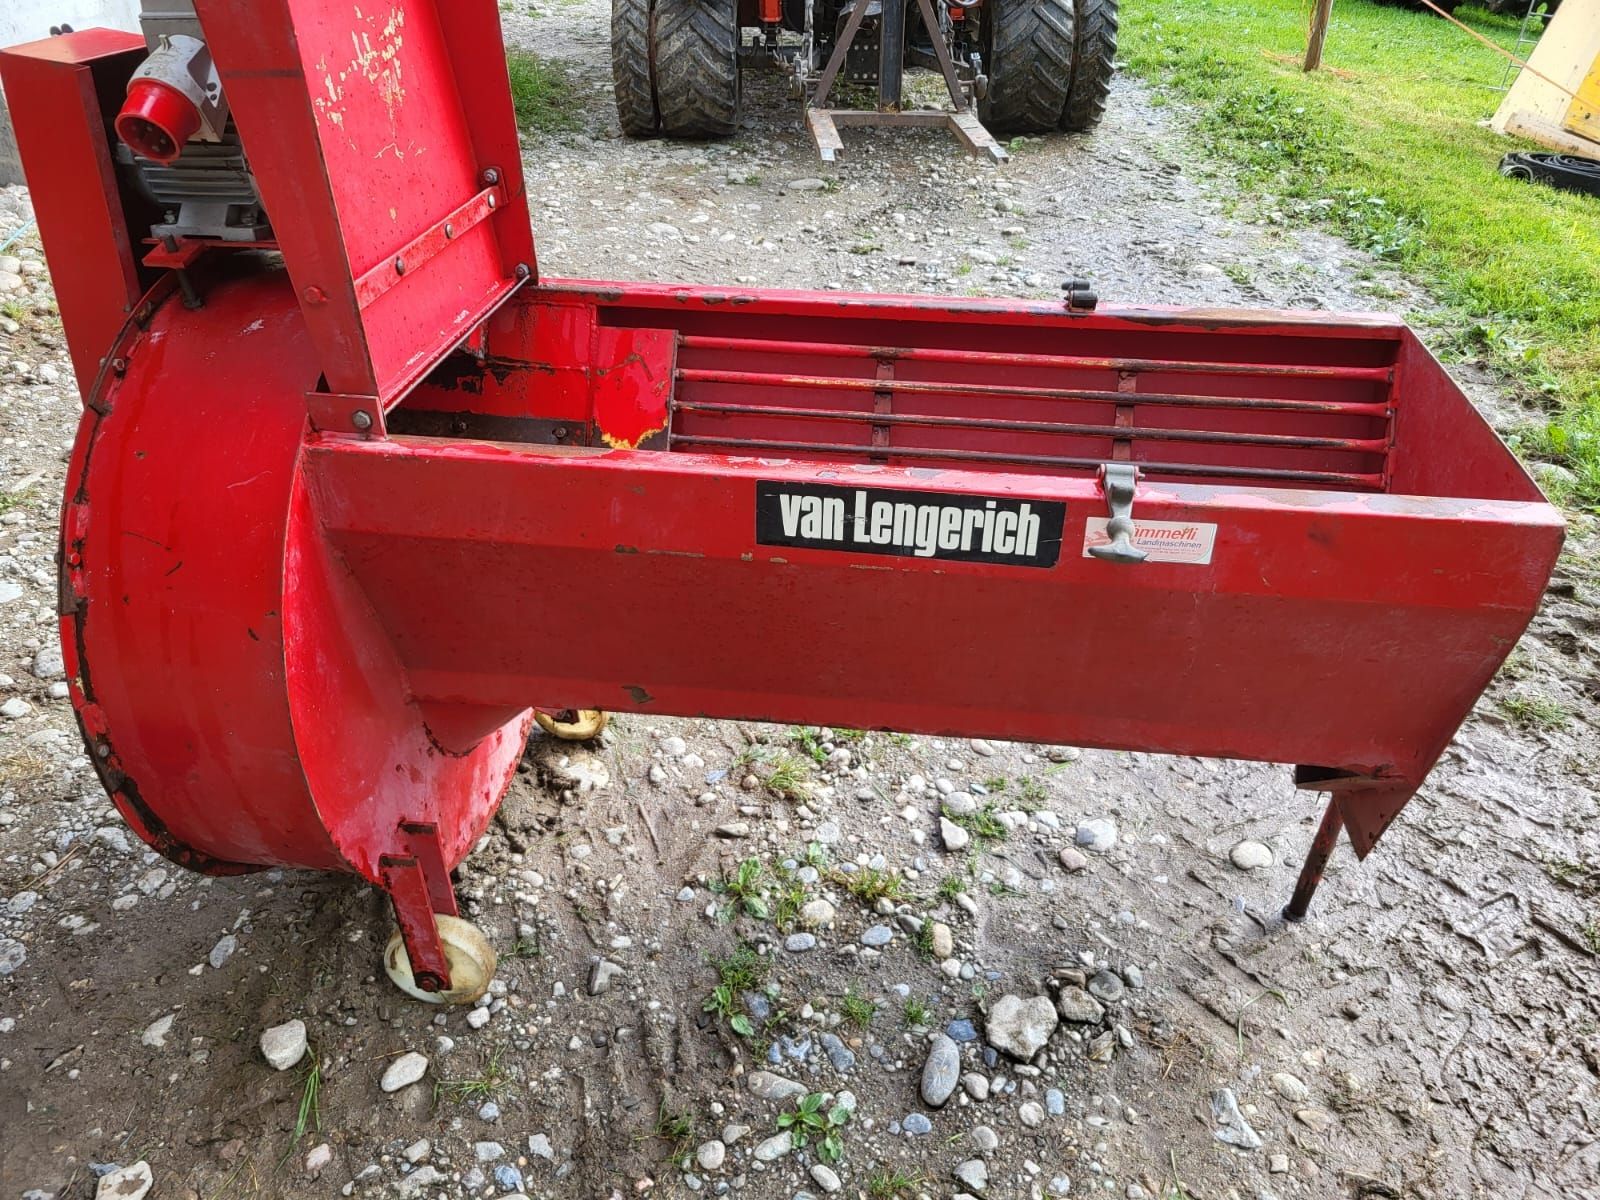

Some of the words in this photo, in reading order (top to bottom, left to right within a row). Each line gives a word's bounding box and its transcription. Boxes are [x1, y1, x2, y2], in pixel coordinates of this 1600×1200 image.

[779, 494, 845, 541] van
[853, 490, 1041, 557] Lengerich
[1136, 539, 1202, 549] Landmaschinen
